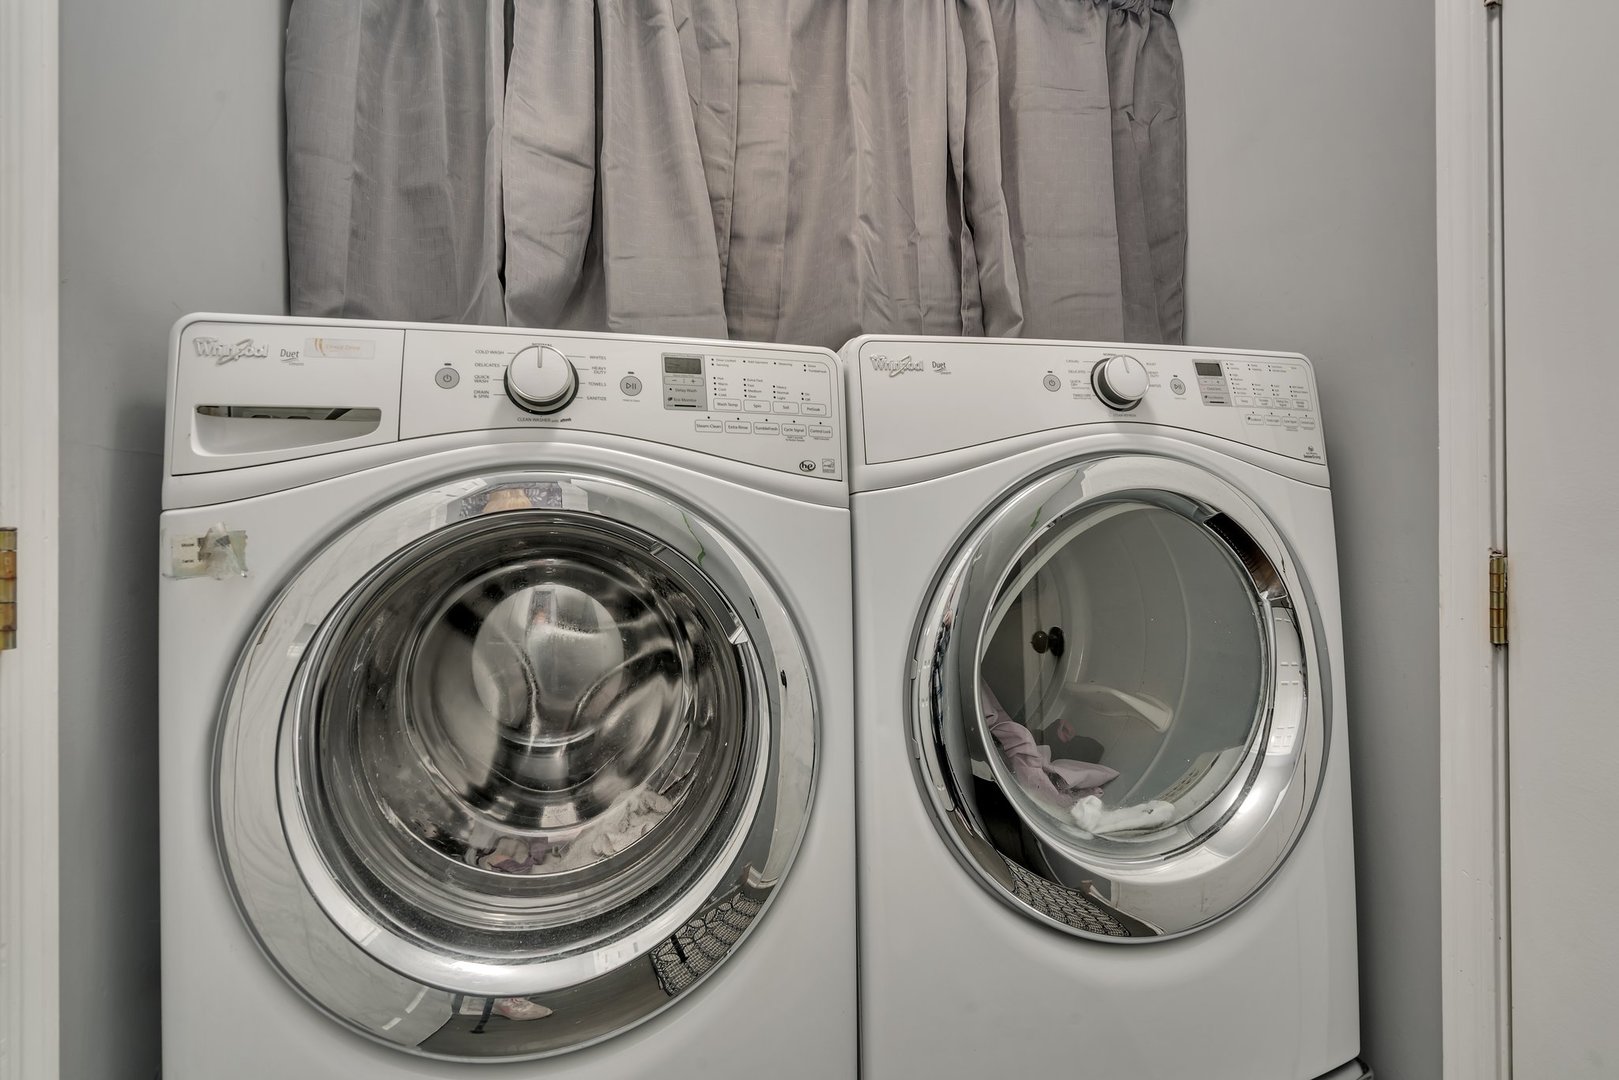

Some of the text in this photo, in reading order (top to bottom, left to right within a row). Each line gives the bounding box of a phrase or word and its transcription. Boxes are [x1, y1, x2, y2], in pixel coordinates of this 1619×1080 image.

[192, 337, 269, 366] Whirlpool
[280, 349, 299, 359] Duet
[869, 355, 924, 378] Whirlpool
[931, 361, 946, 369] Duet
